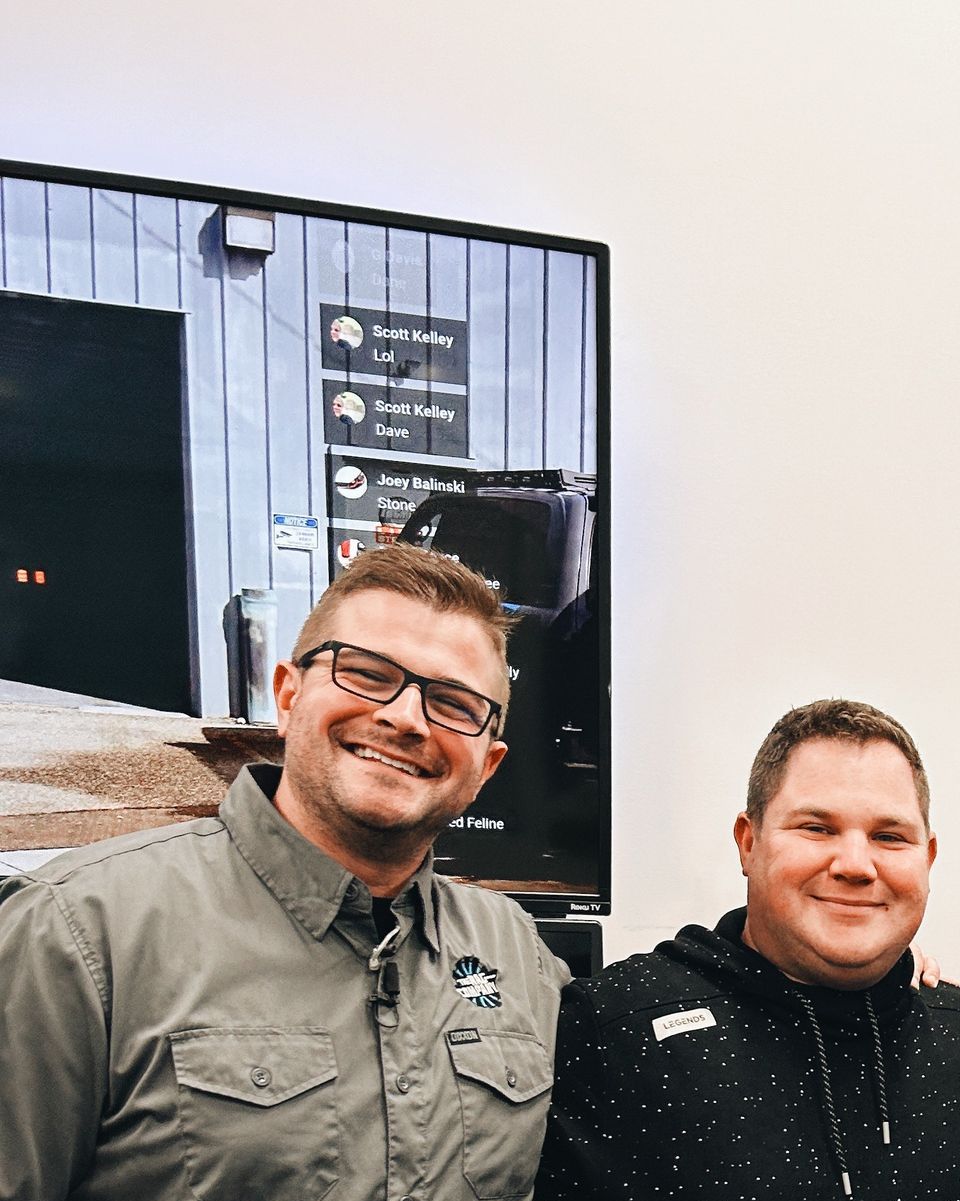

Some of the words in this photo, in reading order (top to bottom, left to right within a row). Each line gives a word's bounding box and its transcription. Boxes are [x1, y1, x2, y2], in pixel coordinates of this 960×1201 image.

[373, 324, 410, 342] Scott
[413, 329, 454, 349] Kelley
[374, 349, 395, 363] Lol
[375, 400, 411, 415] Scott
[415, 404, 455, 422] Kelley
[376, 424, 410, 439] Dave
[377, 474, 410, 490] Joey
[413, 477, 465, 494] Balinski
[378, 497, 416, 512] Stone
[467, 817, 504, 830] Feline
[662, 1014, 706, 1030] LEGENDS
